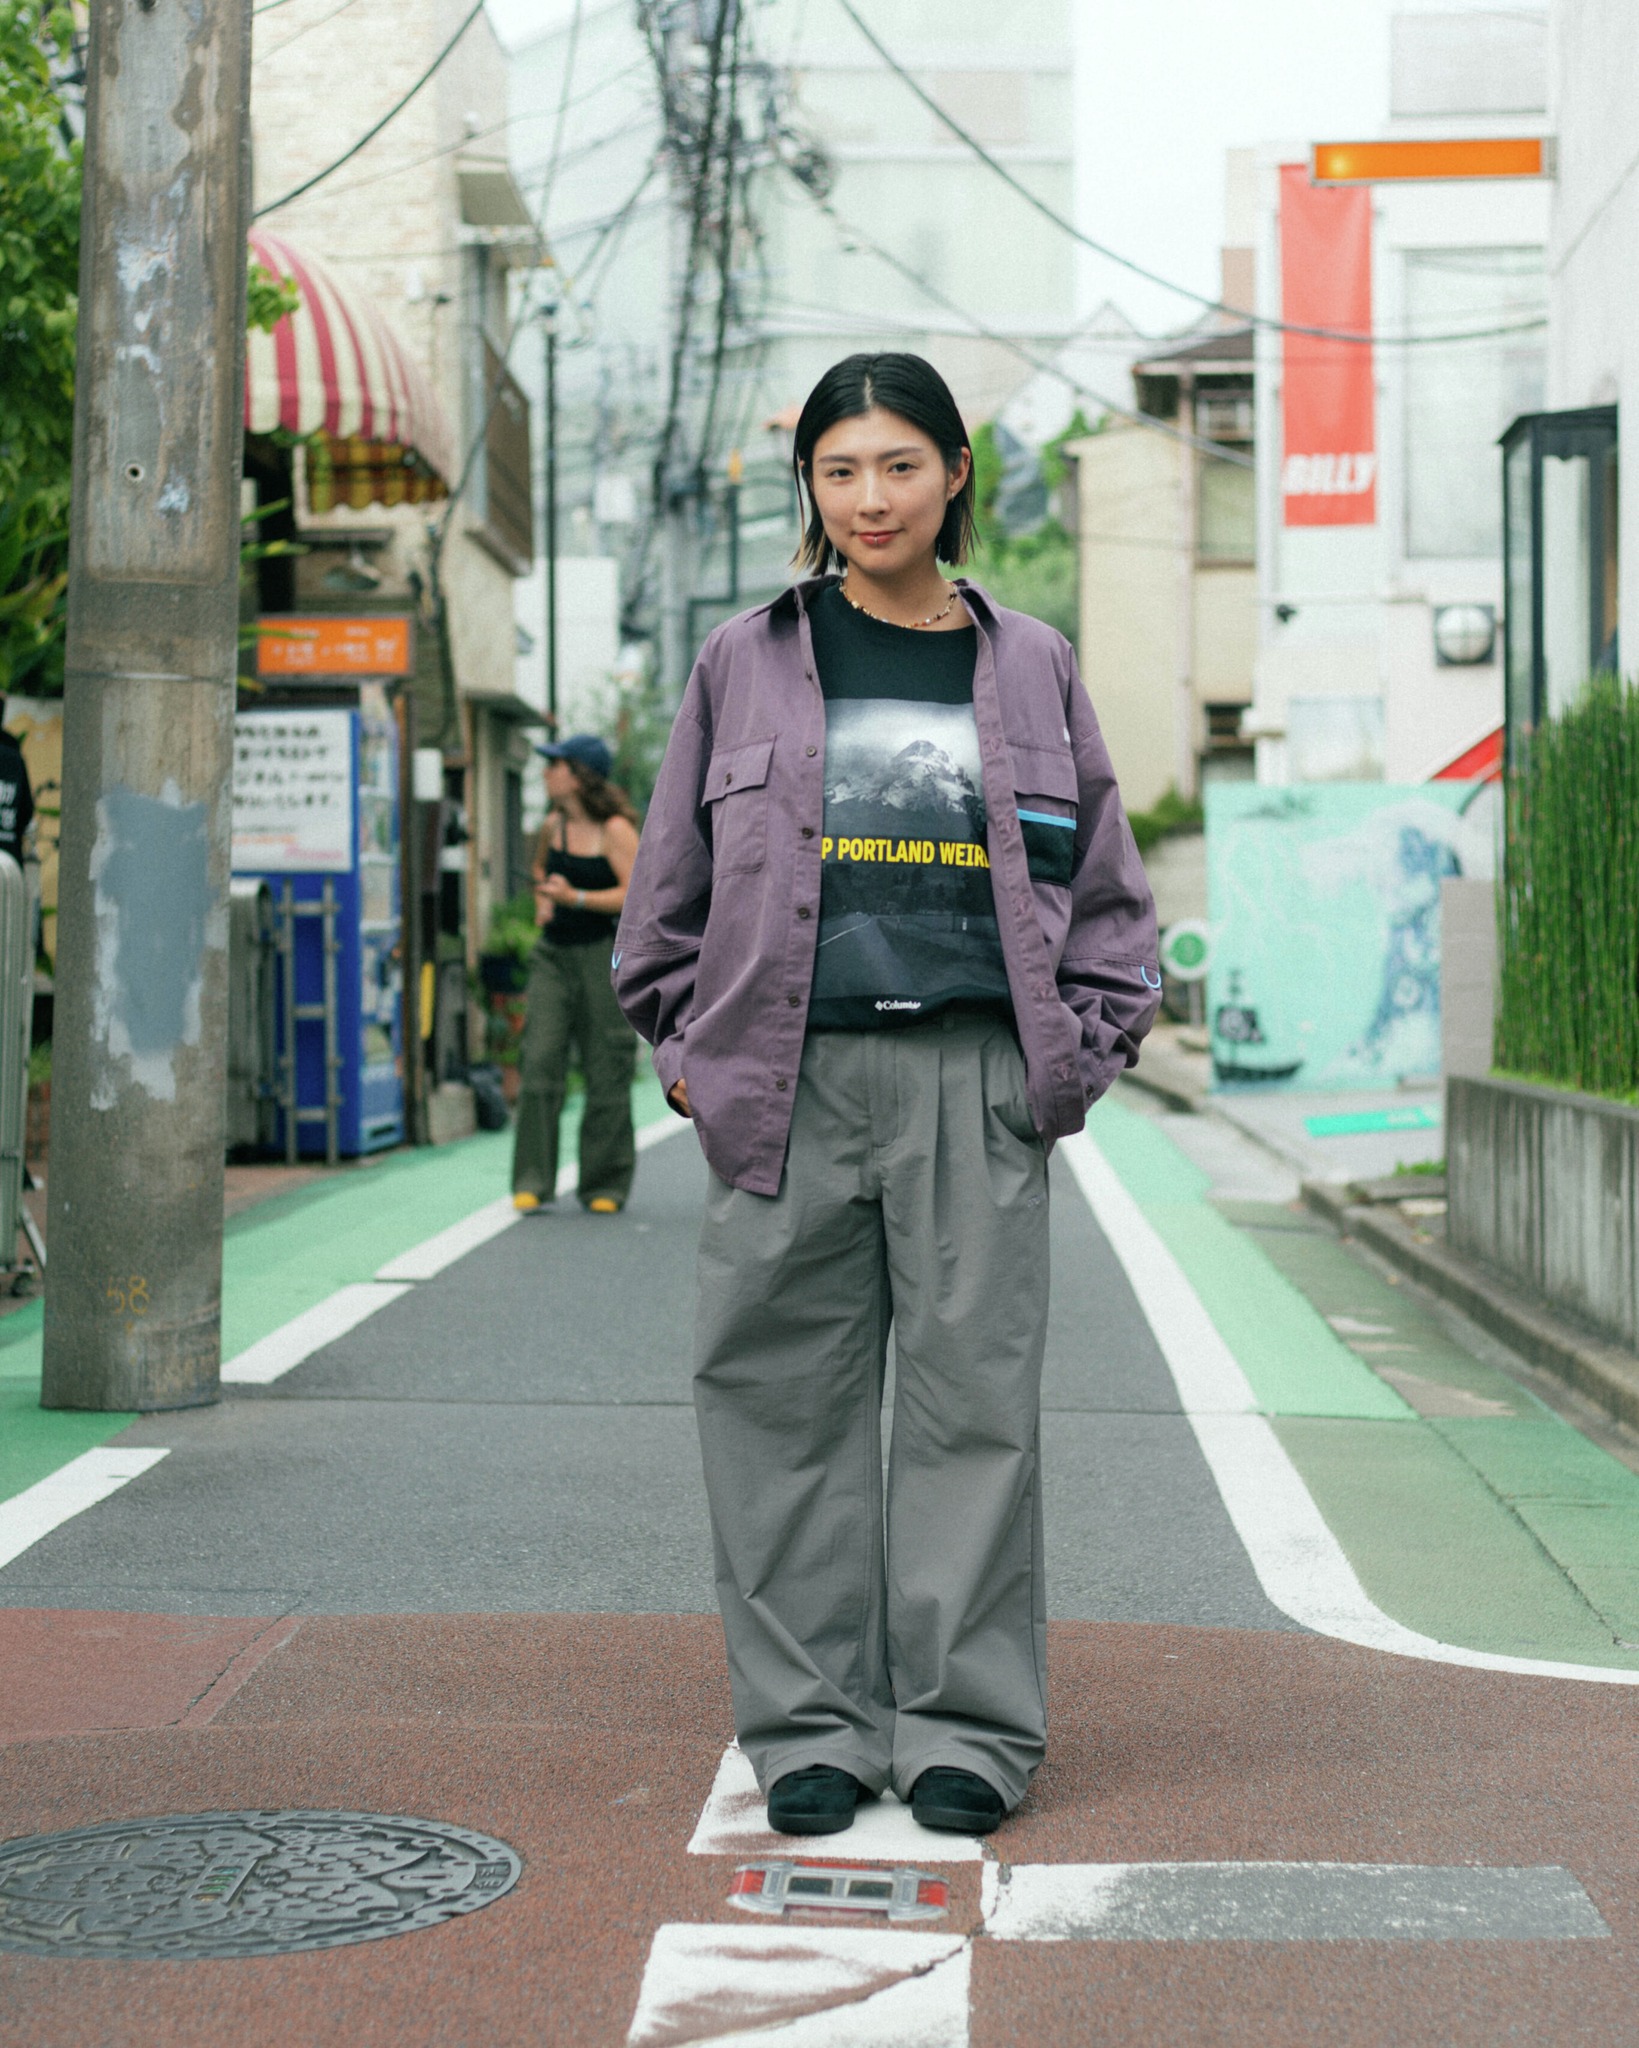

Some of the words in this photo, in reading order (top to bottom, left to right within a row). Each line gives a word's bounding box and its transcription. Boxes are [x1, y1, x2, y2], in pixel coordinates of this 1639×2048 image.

[1282, 453, 1376, 494] BILLY
[837, 838, 935, 863] PORTLAND
[939, 842, 990, 868] WEIR
